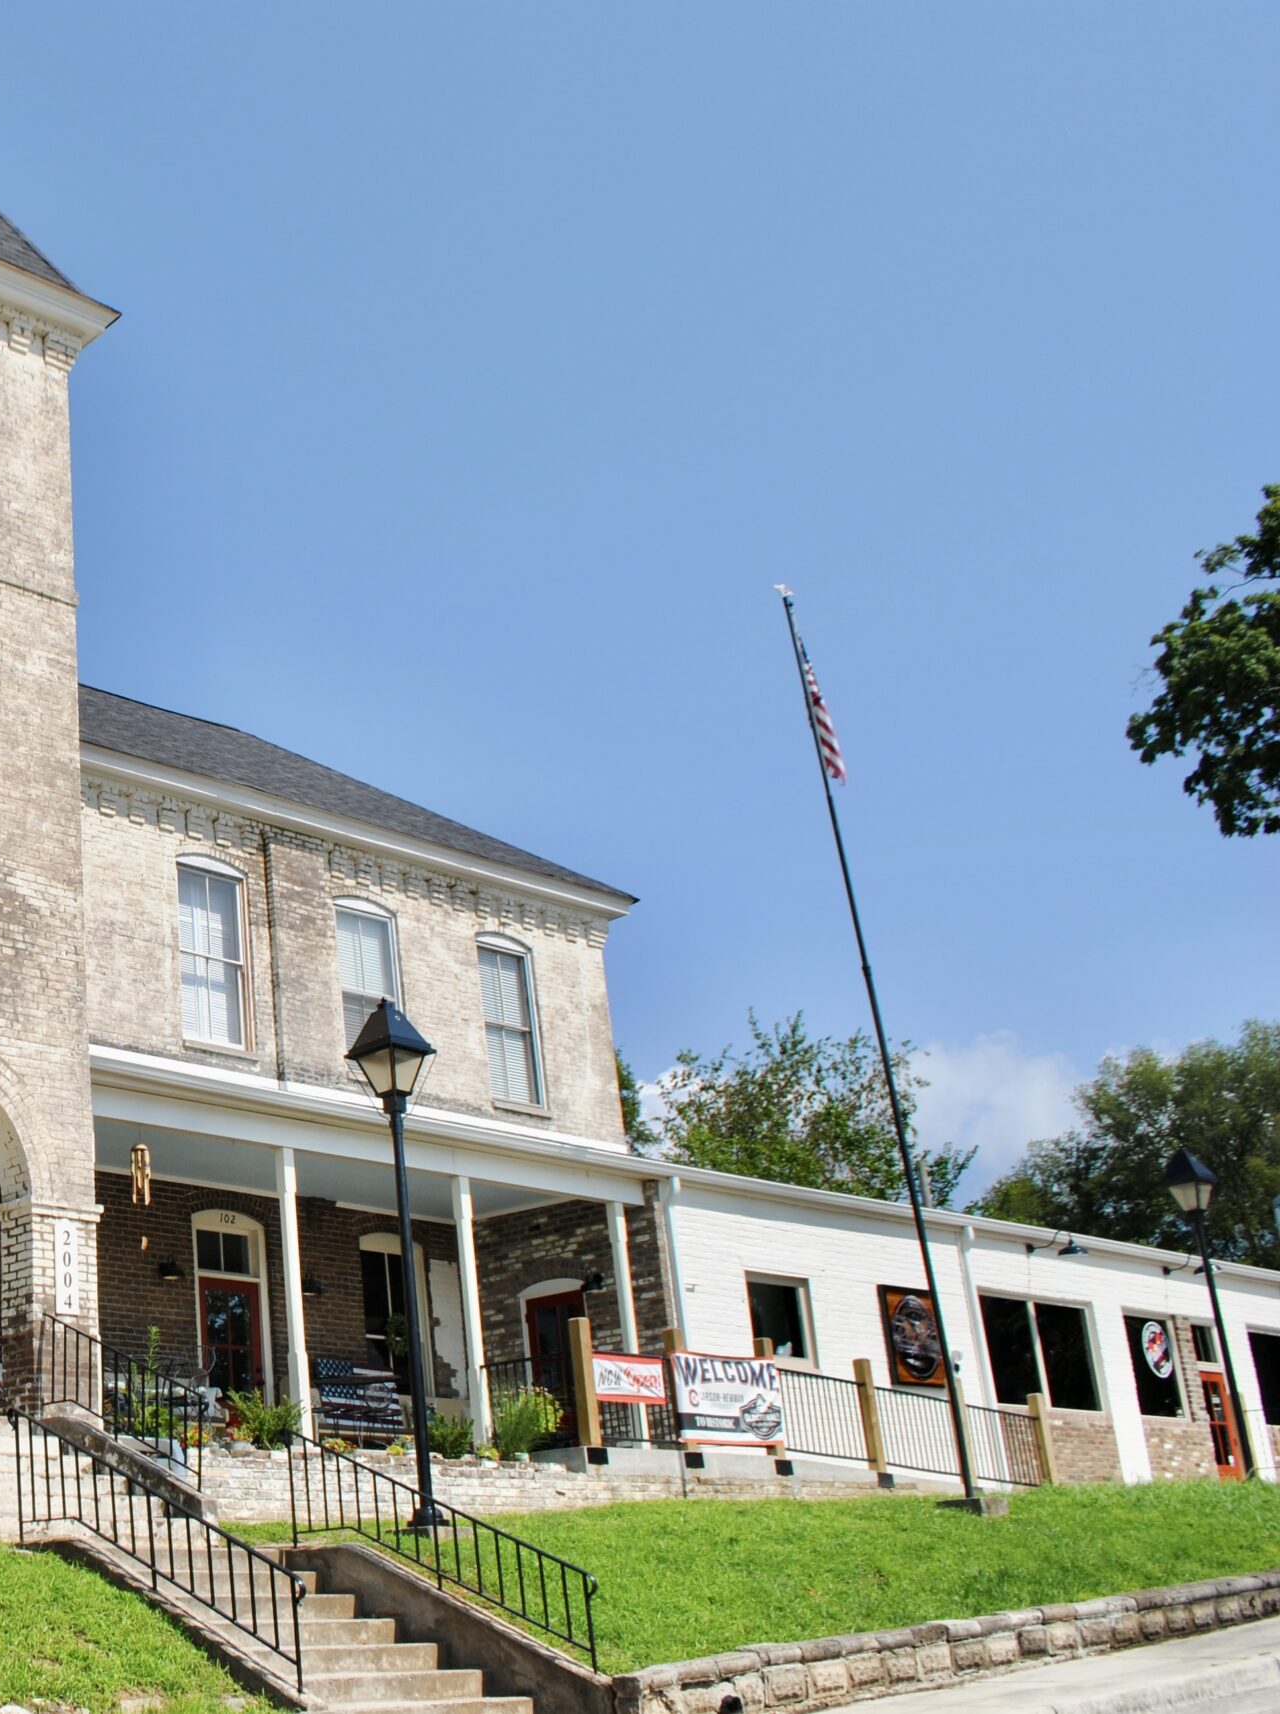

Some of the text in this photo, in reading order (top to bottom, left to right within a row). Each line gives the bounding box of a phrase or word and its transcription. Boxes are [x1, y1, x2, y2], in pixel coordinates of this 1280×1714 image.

[220, 1213, 236, 1224] 102
[62, 1229, 73, 1309] 2004
[598, 1367, 622, 1387] NOW
